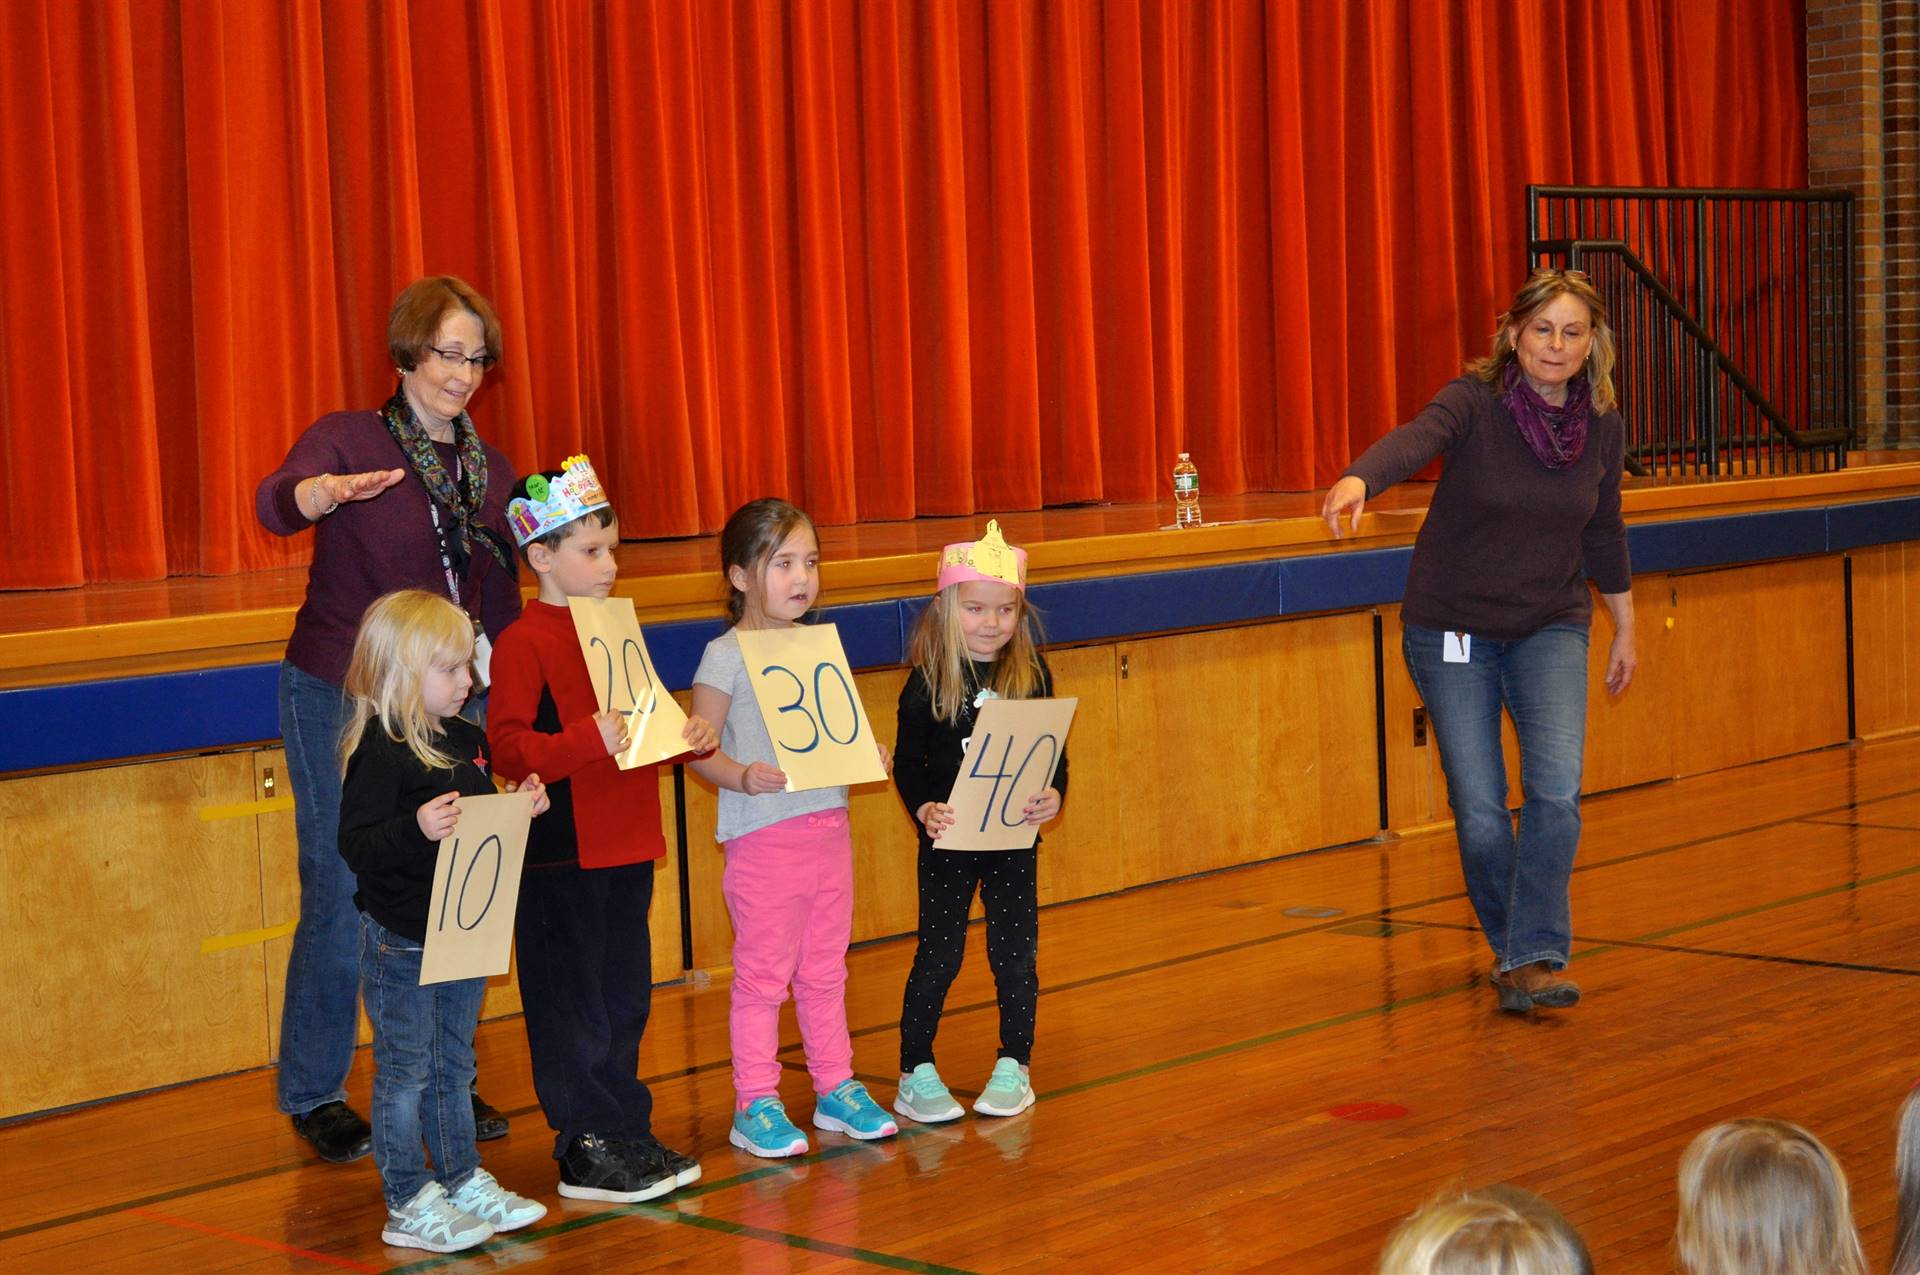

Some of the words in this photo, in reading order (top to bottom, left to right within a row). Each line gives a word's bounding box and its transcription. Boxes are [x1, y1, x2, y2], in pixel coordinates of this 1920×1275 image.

[589, 636, 657, 716] 20
[761, 661, 859, 754] 30
[969, 732, 1058, 833] 40
[438, 833, 502, 932] 10
